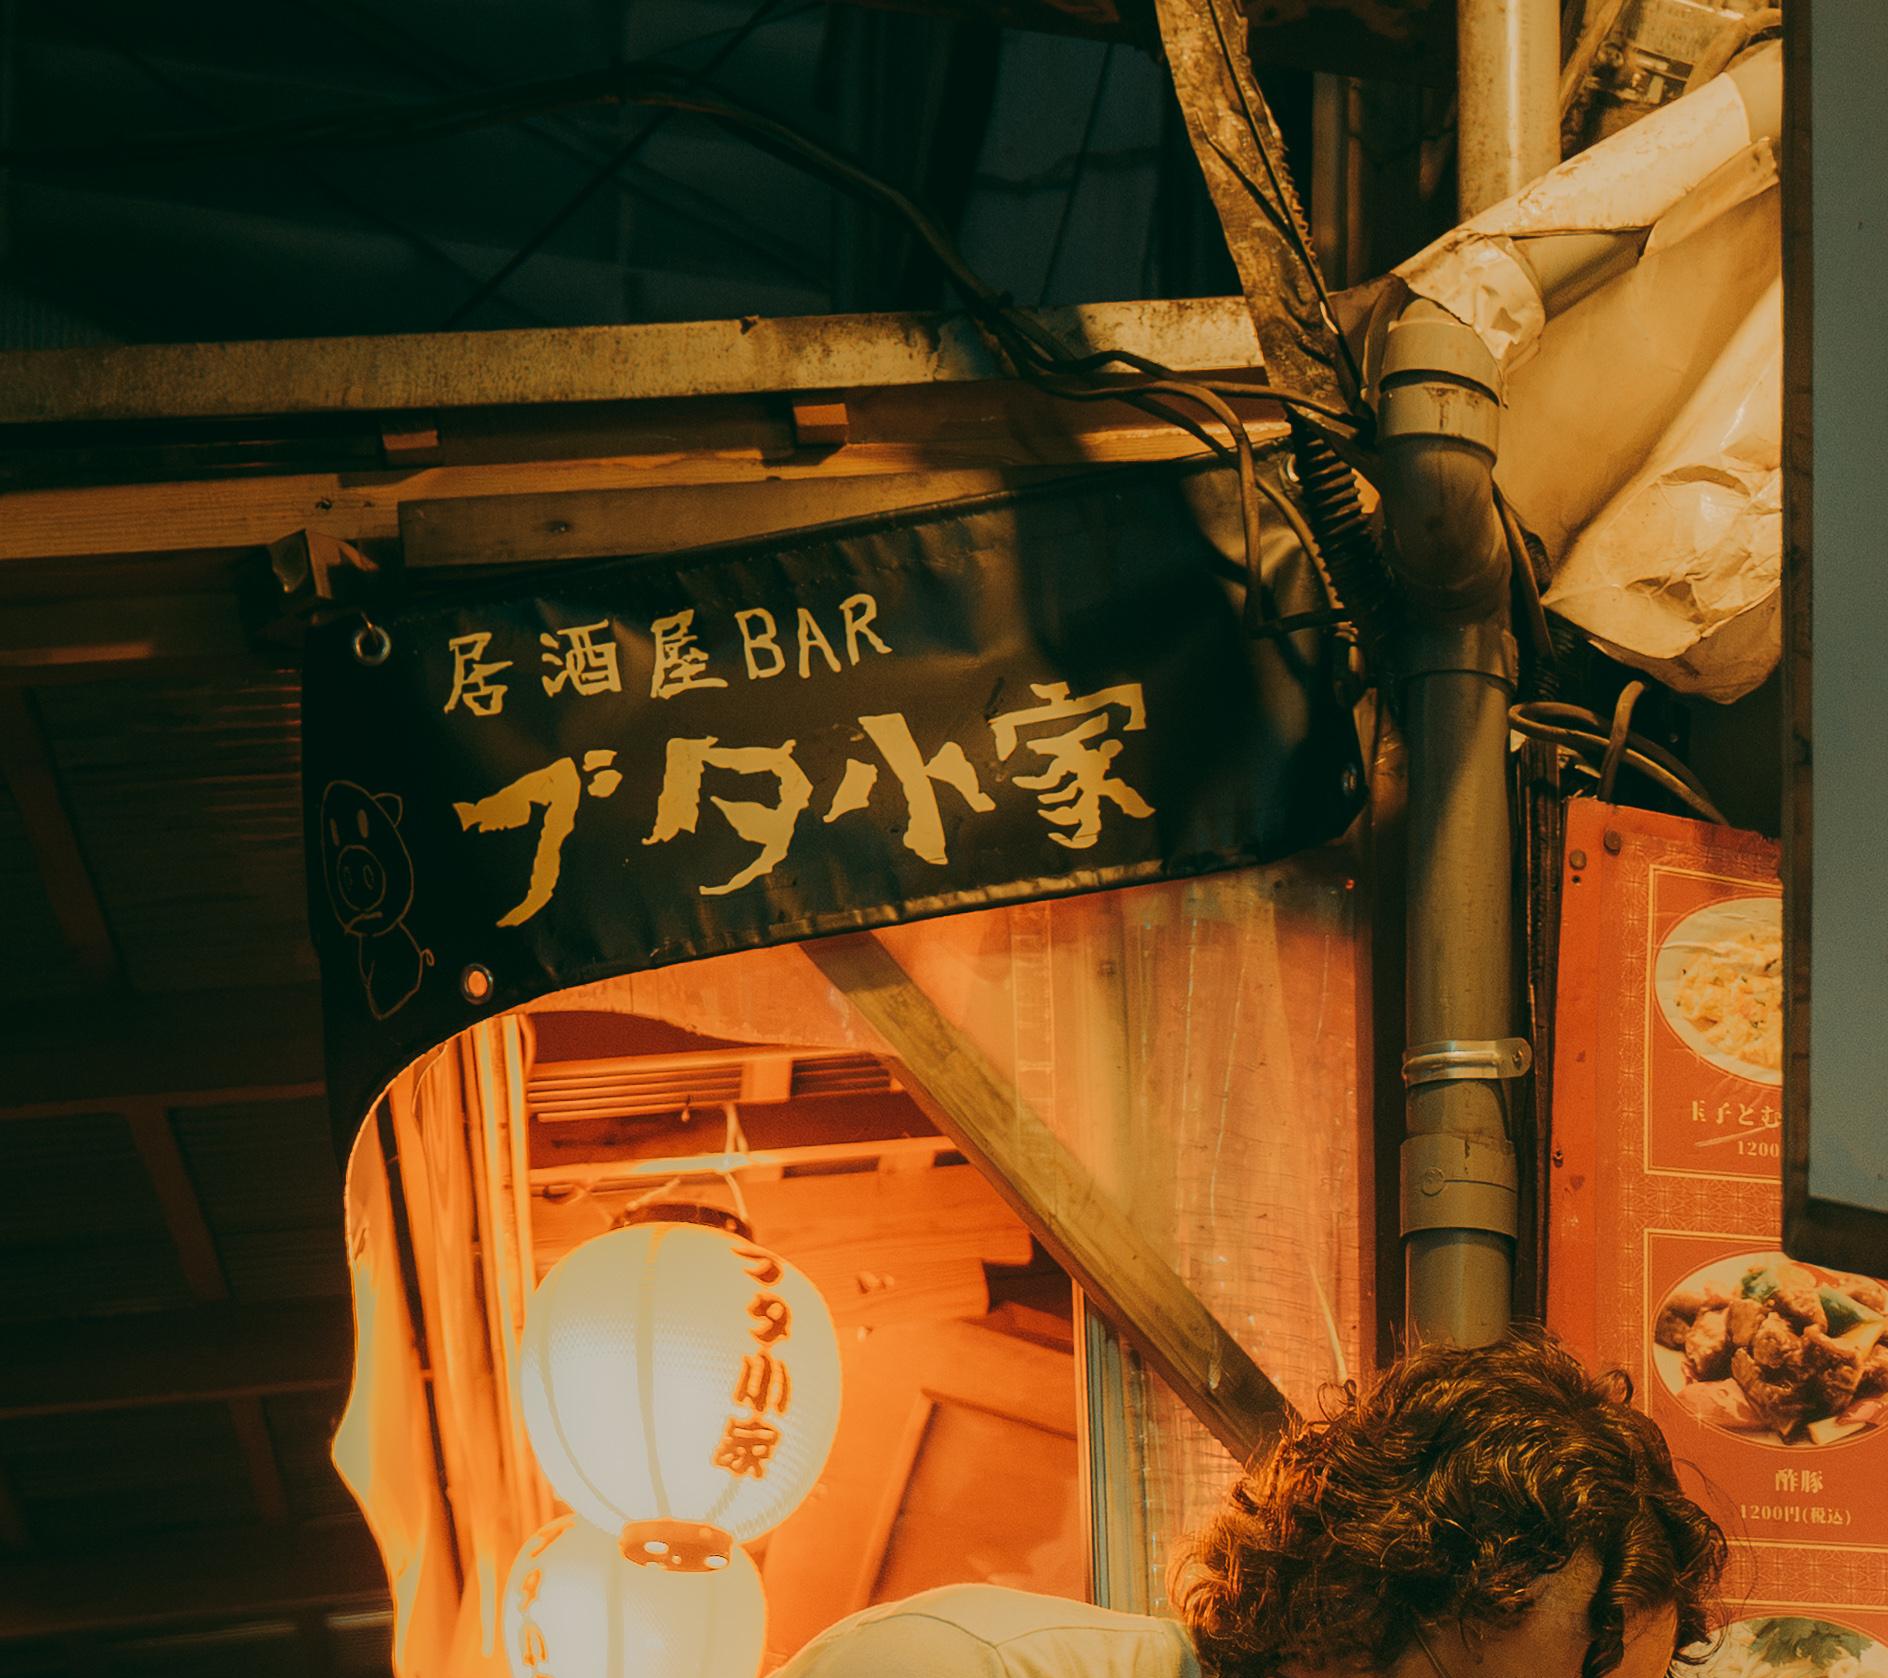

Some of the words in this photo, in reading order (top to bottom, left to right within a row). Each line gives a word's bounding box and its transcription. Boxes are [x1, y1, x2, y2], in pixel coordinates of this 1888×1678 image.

[453, 681, 1157, 928] ブタ小家
[1775, 1468, 1824, 1494] 酢豚
